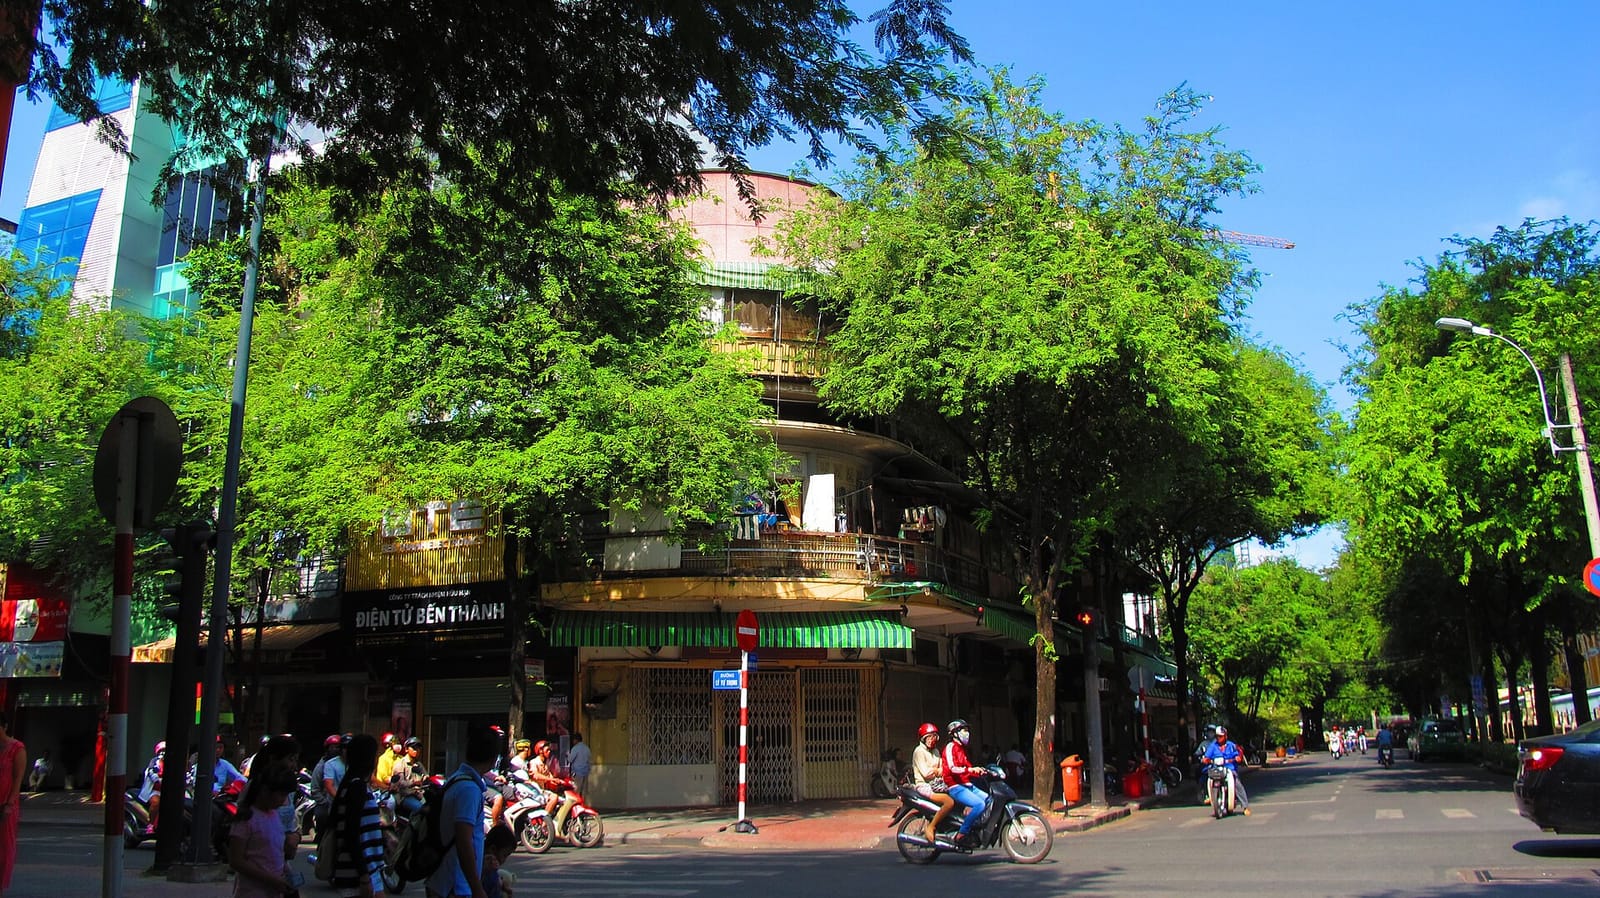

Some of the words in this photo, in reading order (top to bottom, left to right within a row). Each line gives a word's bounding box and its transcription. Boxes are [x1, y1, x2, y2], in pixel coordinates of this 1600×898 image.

[355, 607, 390, 631] ĐIỆN
[392, 603, 414, 625] TỬ
[416, 601, 446, 624] BẾN
[449, 600, 505, 623] THÀNH
